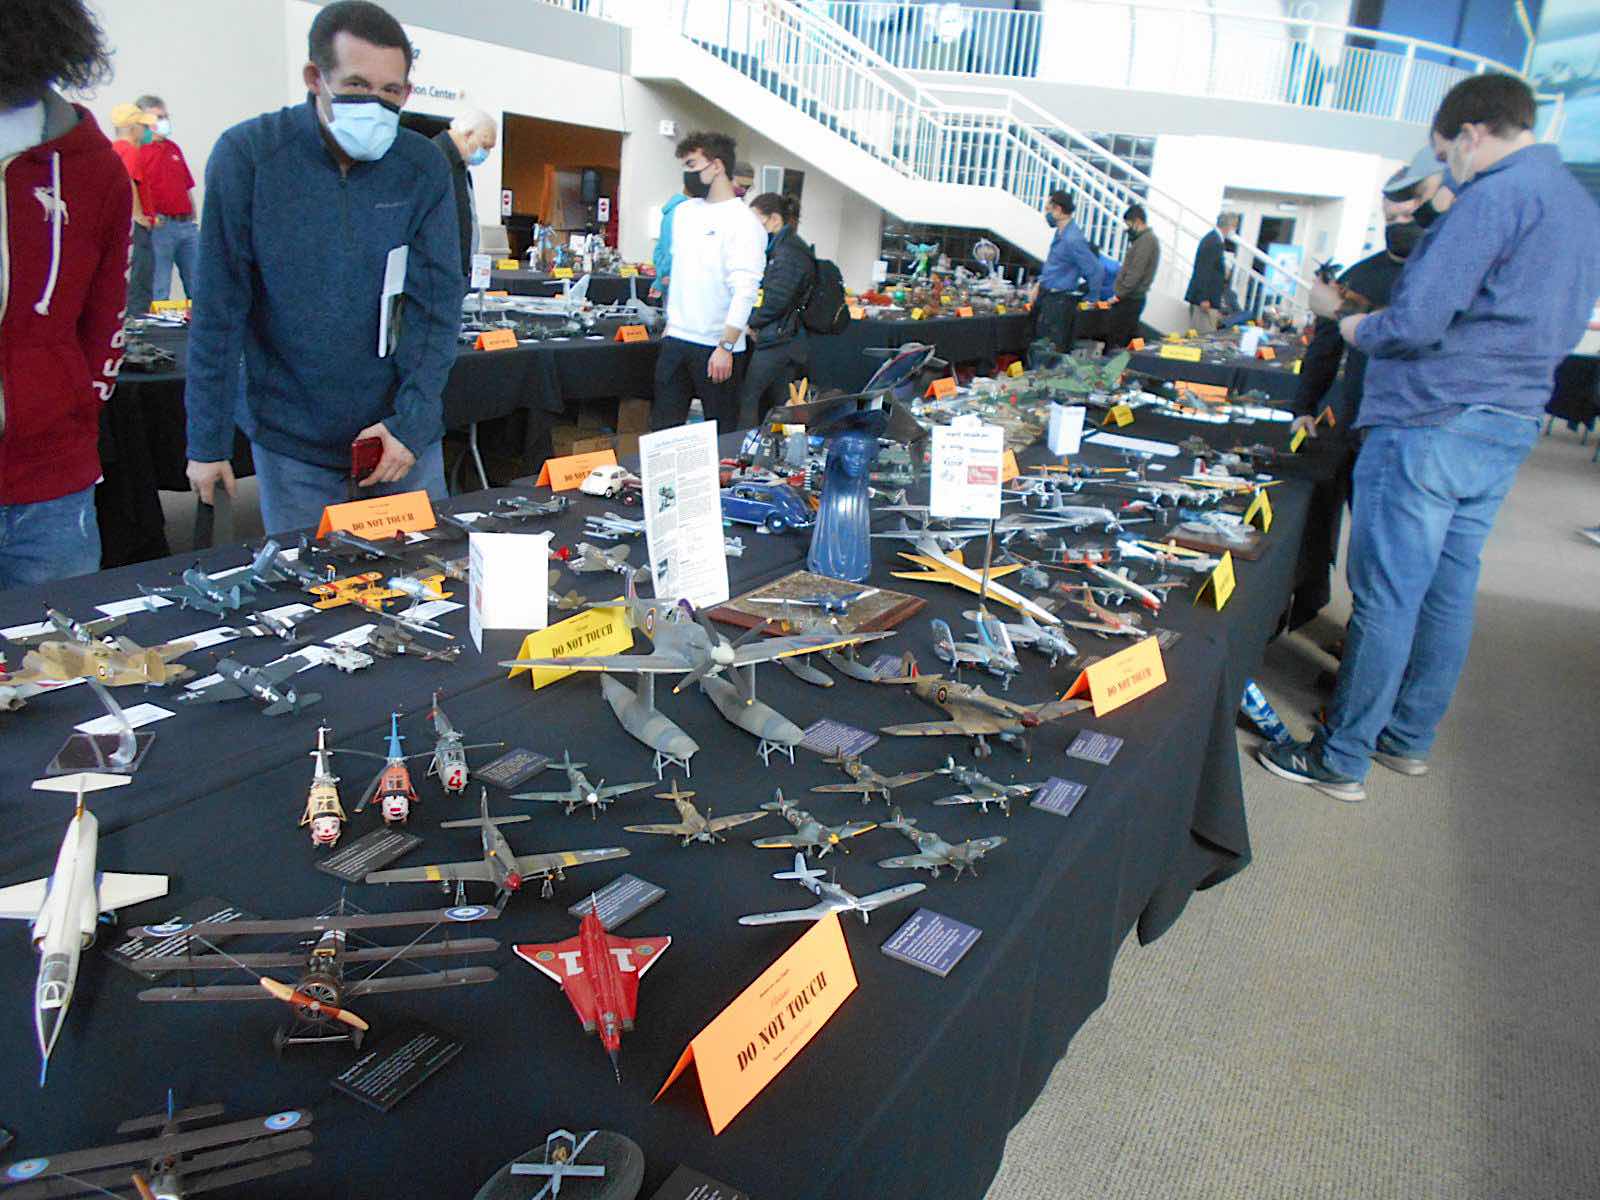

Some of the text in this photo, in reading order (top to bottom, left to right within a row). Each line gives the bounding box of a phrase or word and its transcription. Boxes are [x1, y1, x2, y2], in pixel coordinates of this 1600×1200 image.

[430, 86, 456, 99] Center
[352, 513, 415, 531] DO NOT TOUCH
[552, 644, 564, 658] DO
[566, 636, 583, 652] NOT
[586, 623, 613, 643] TOUCH
[1291, 754, 1307, 771] N
[448, 769, 462, 788] 4
[737, 1041, 757, 1072] DO
[758, 1011, 785, 1050] NOT
[786, 970, 827, 1019] TOUCH
